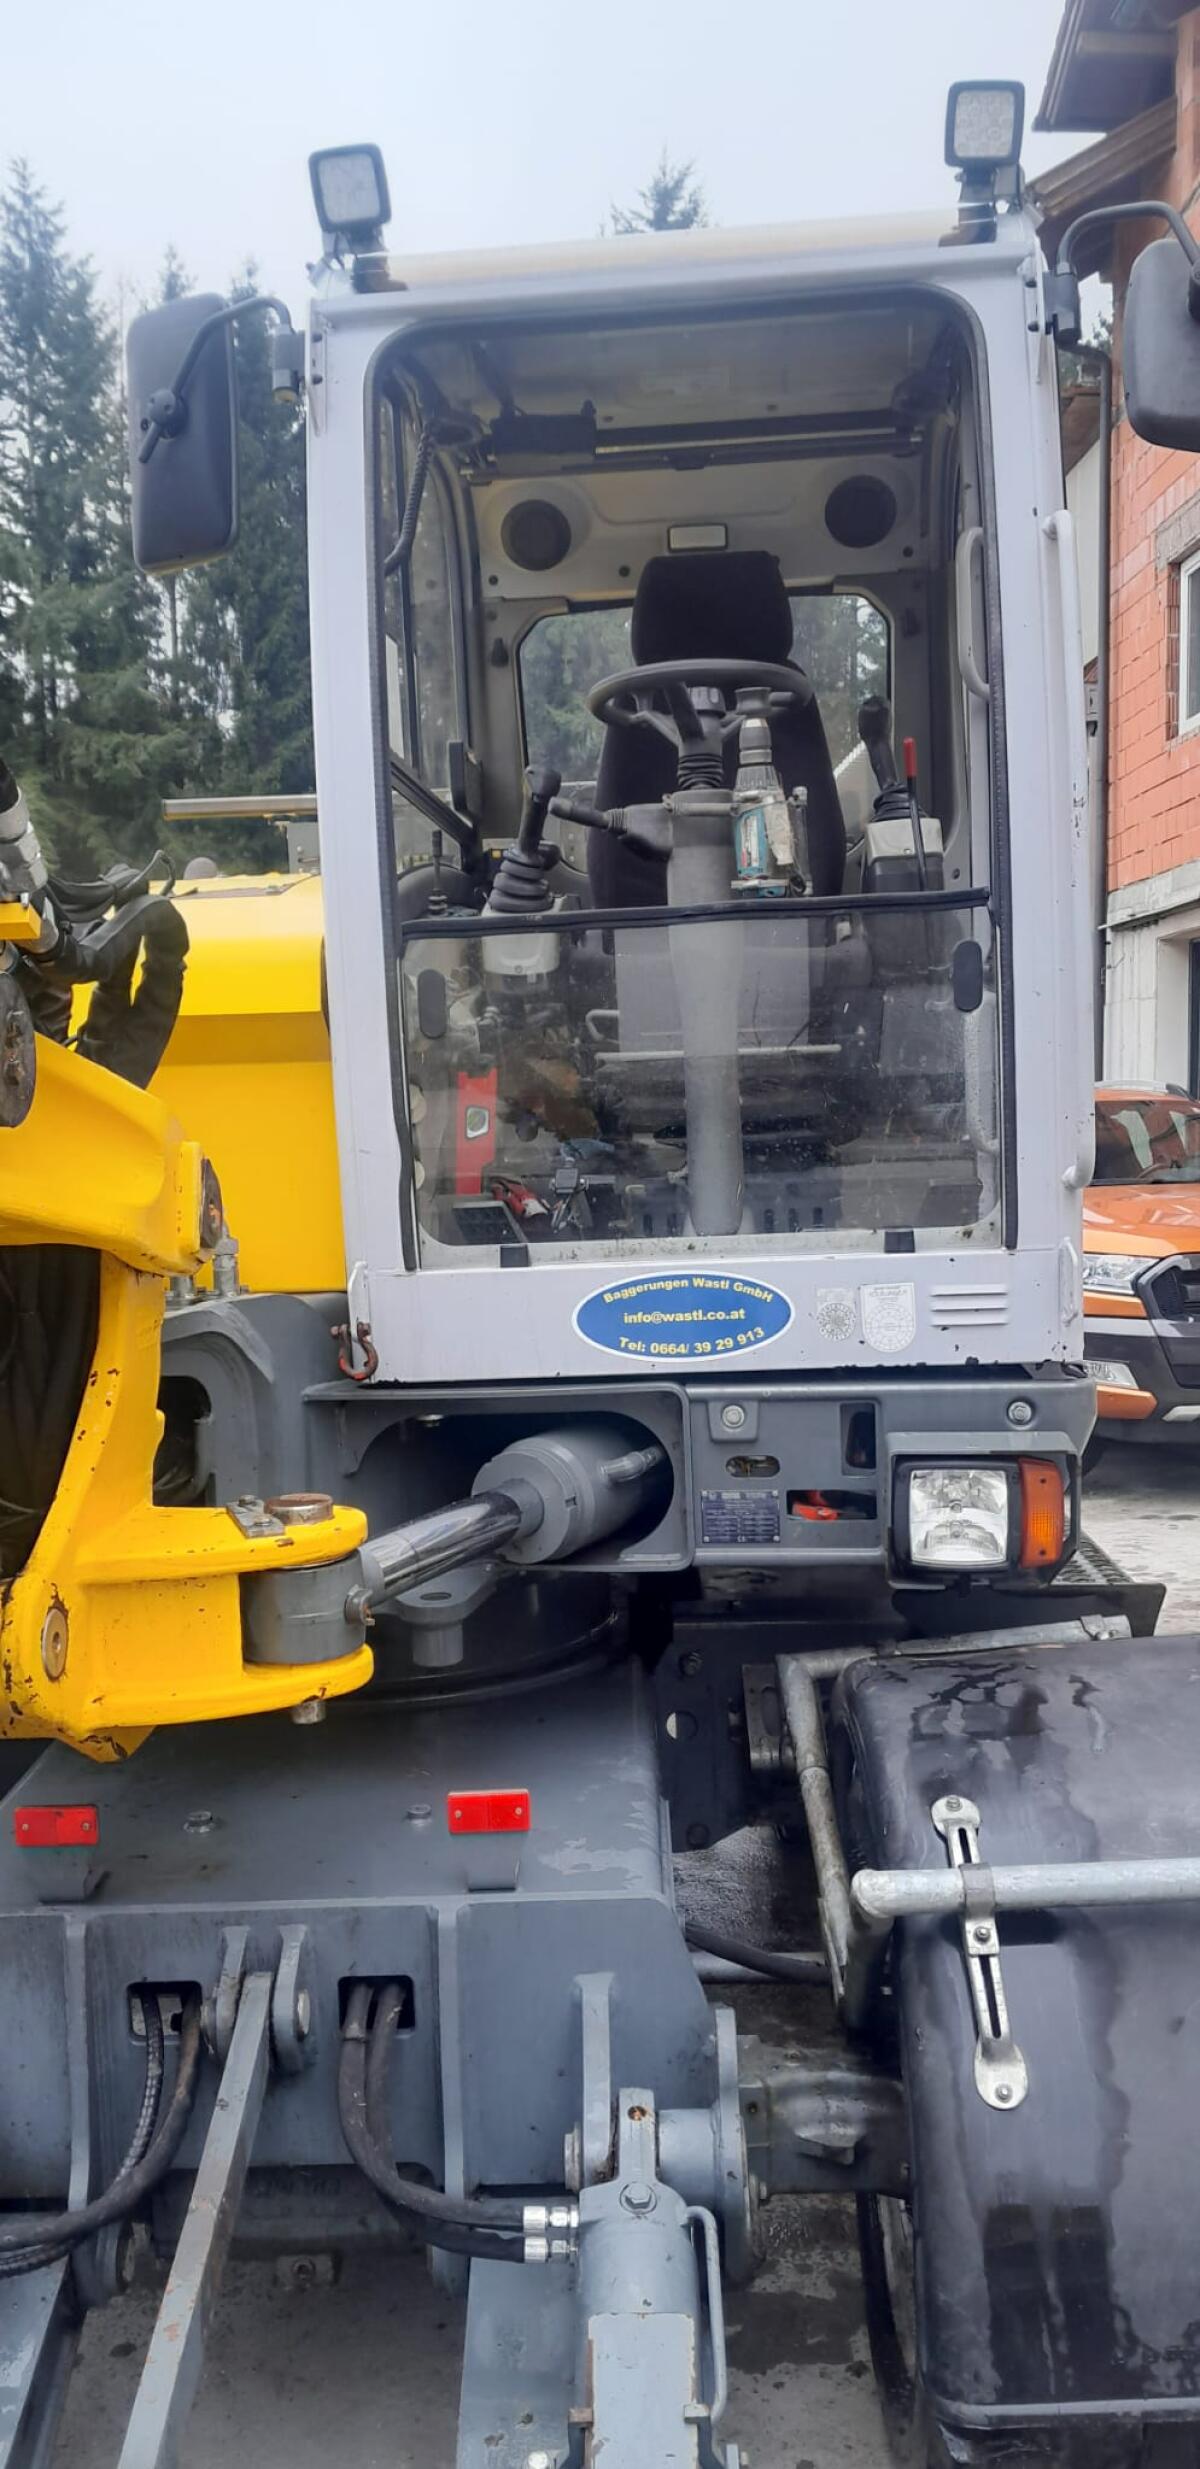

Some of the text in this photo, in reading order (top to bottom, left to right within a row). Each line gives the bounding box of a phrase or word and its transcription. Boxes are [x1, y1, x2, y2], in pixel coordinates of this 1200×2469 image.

[603, 1277, 773, 1303] Baggerungen Wastl GmbH
[623, 1308, 746, 1324] info@wastl.co.at
[619, 1327, 765, 1355] Tel: 0664/ 39 29 913
